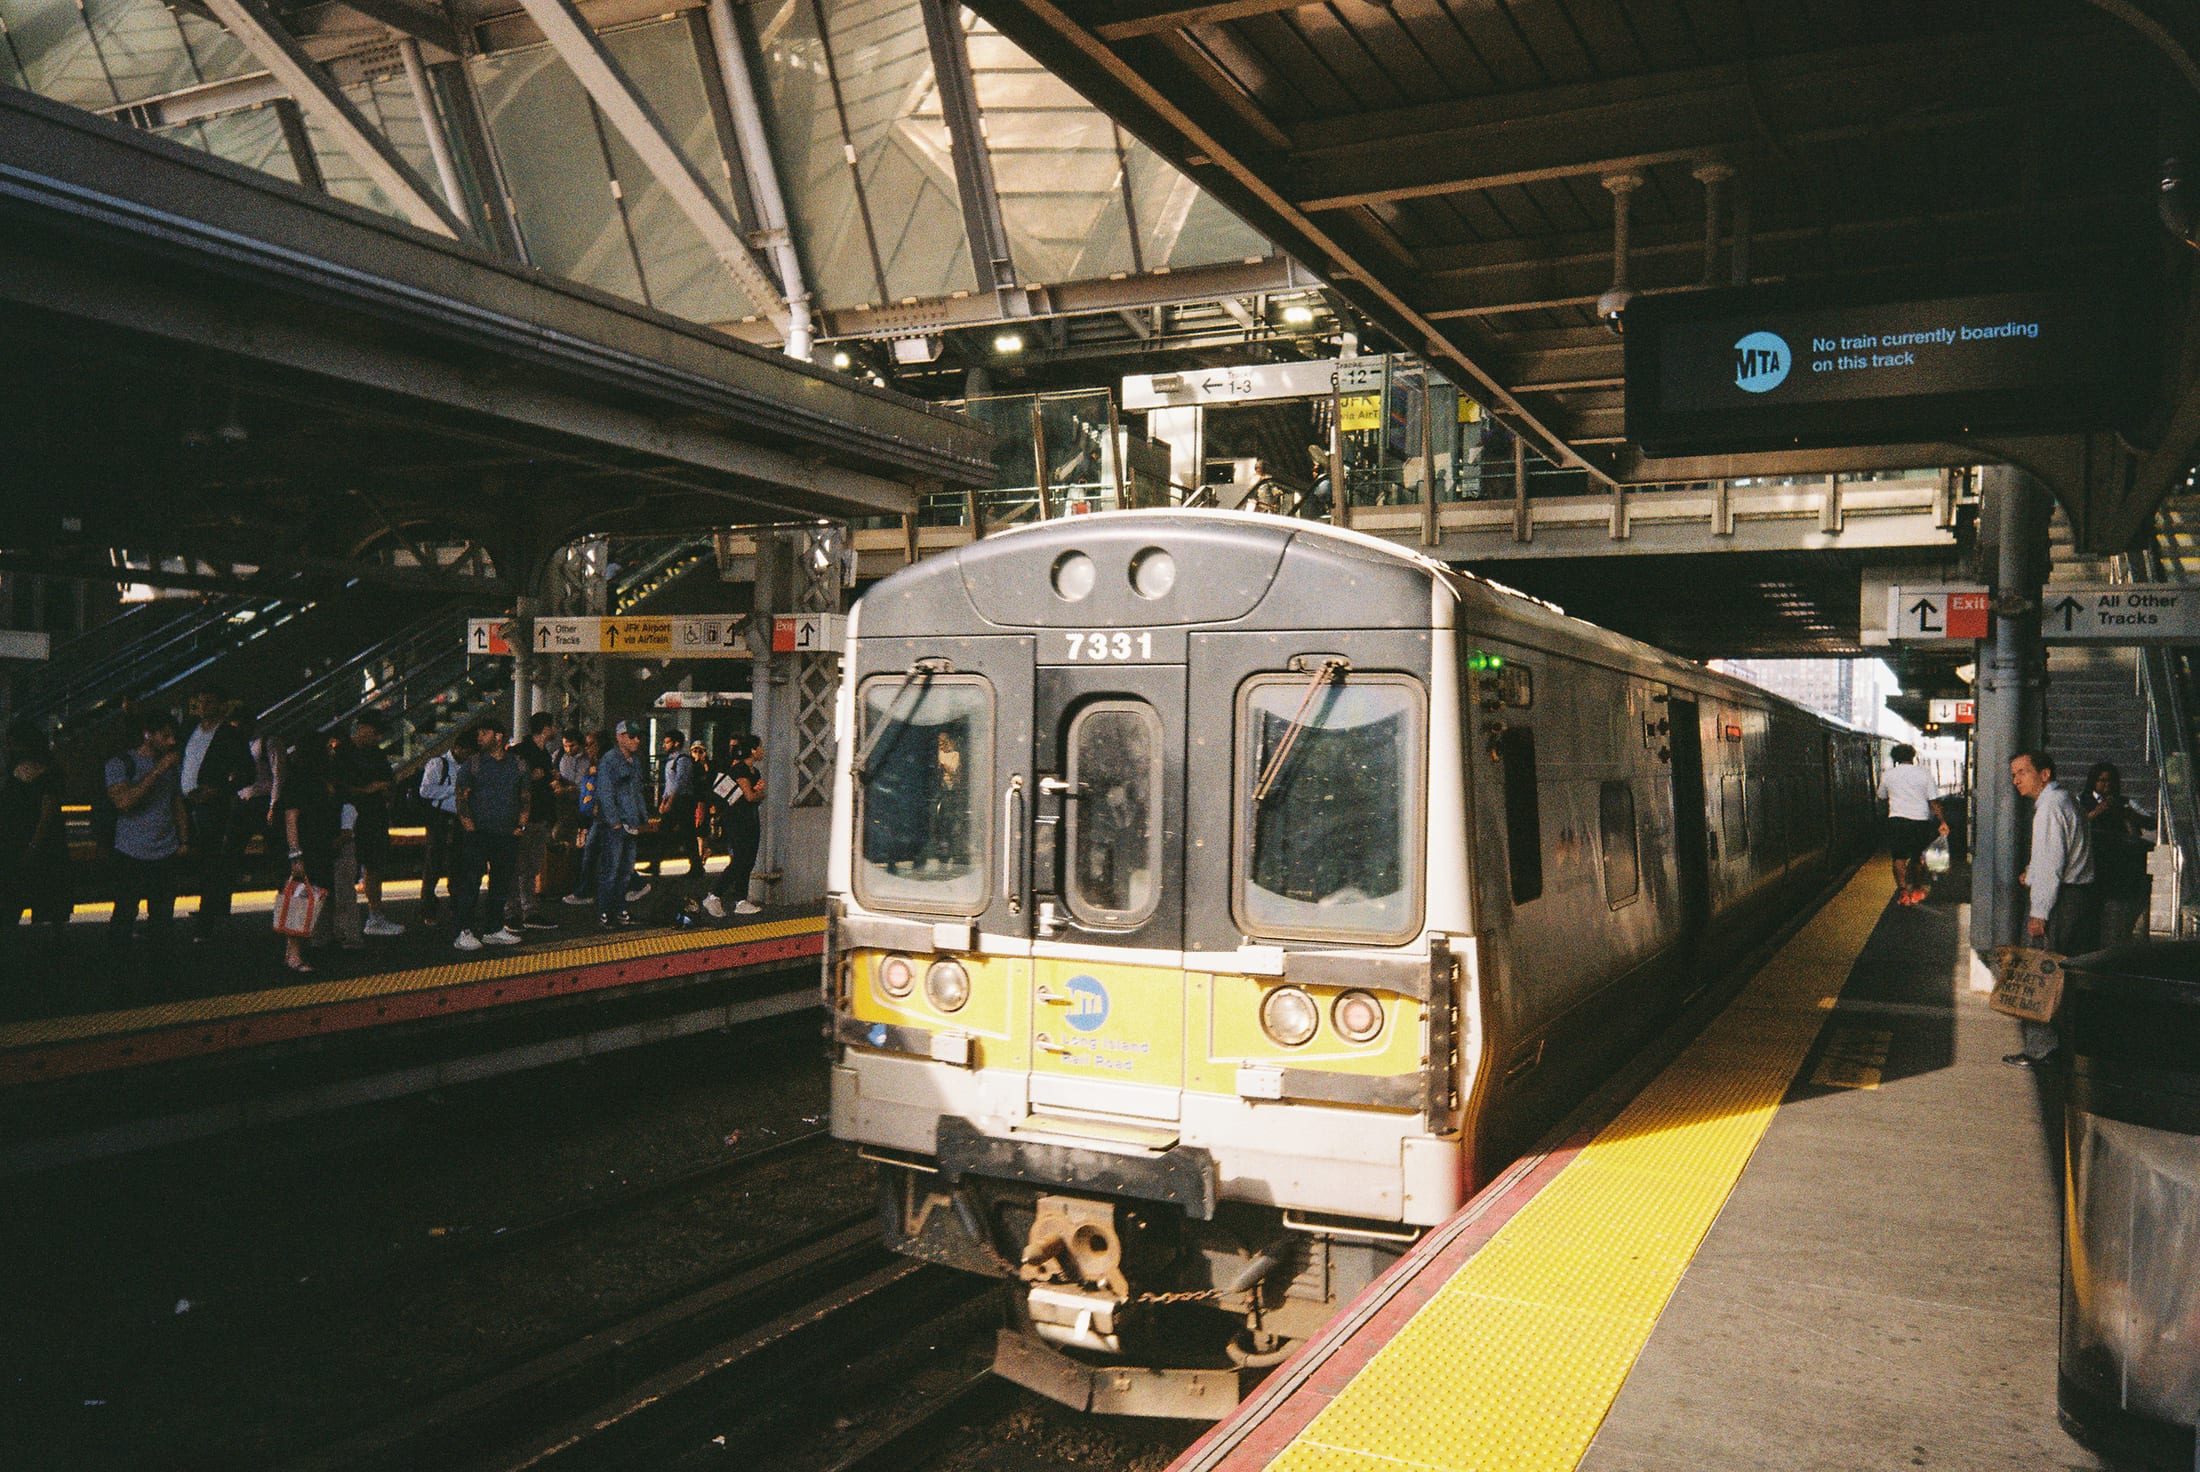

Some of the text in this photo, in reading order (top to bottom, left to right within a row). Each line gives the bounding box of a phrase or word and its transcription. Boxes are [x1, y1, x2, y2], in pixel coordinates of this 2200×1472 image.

[1812, 322, 2039, 352] No train currently boarding
[1736, 349, 1780, 380] MTA
[1812, 351, 1915, 372] on this track
[1229, 380, 1252, 394] 1-3
[1952, 597, 1985, 610] Exit
[2098, 595, 2177, 608] All Other
[2098, 611, 2158, 625] Tracks
[555, 624, 577, 634] Other
[775, 621, 794, 632] Exit
[555, 636, 580, 645] Tracks
[1065, 632, 1152, 660] 7331
[1062, 1033, 1097, 1050] Long
